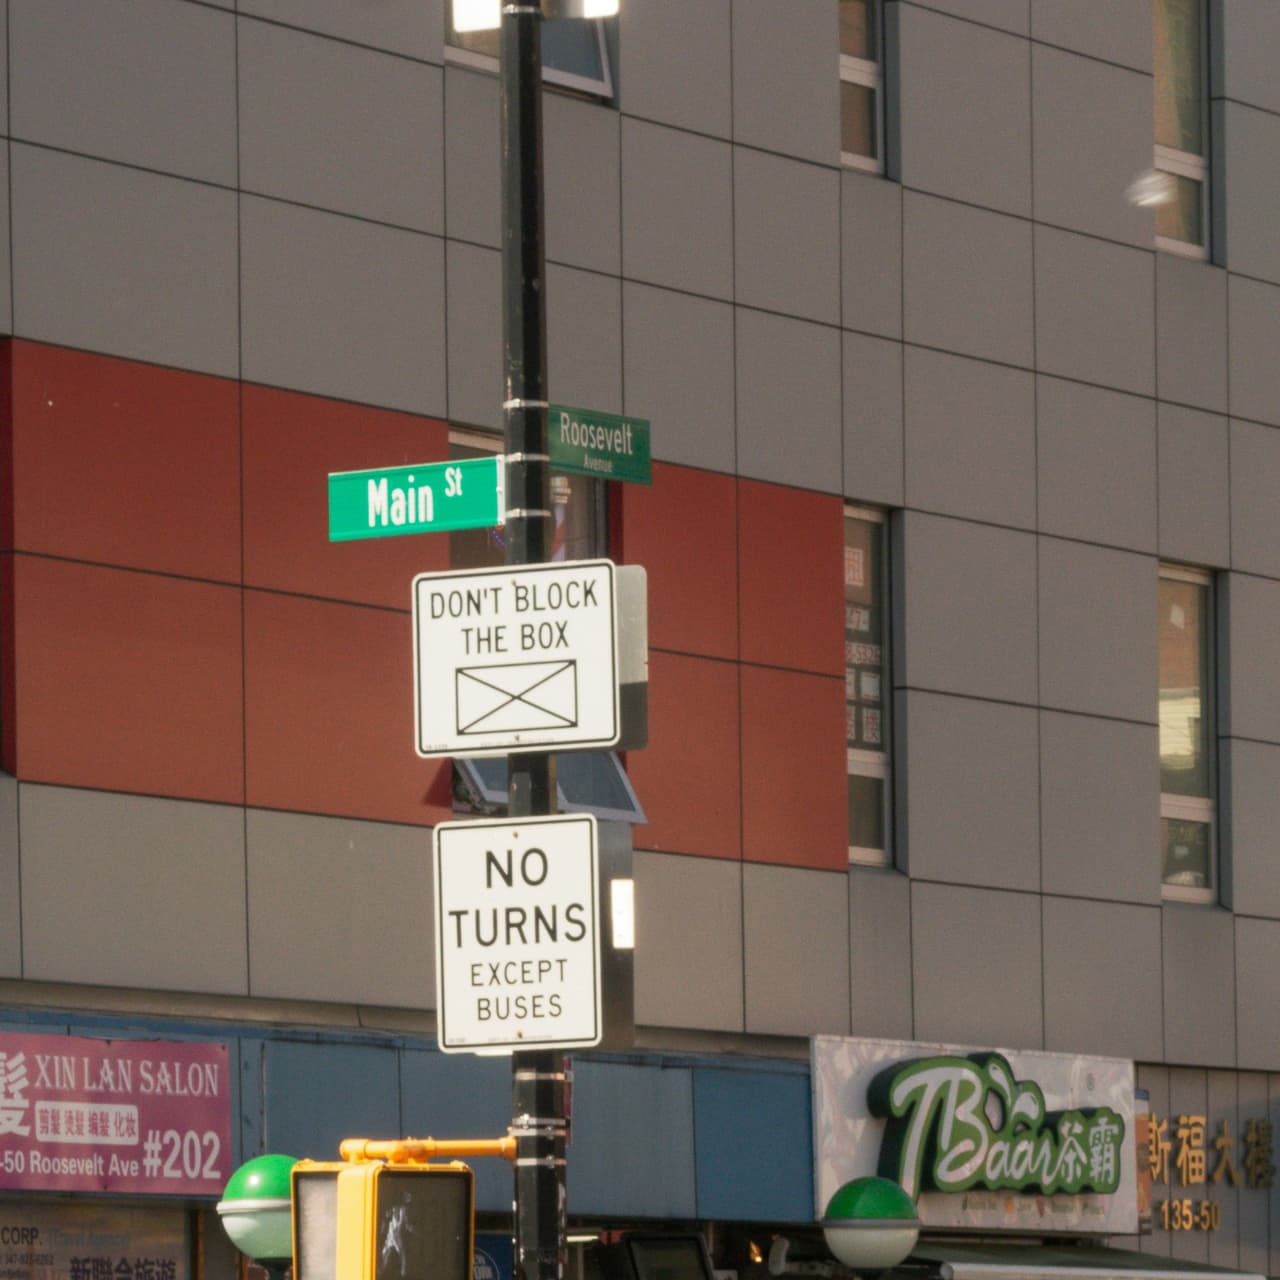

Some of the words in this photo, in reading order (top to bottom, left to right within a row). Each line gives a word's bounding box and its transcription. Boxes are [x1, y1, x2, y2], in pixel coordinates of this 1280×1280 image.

[560, 412, 633, 455] Roosevelt
[583, 454, 614, 473] Avenue
[367, 475, 433, 527] Main
[445, 467, 463, 497] St
[430, 587, 503, 619] DON'T
[514, 580, 598, 612] BLOCK
[461, 625, 508, 655] THE
[521, 621, 569, 650] BOX
[486, 848, 548, 888] NO
[448, 903, 587, 948] TURNS
[471, 958, 568, 987] EXCEPT
[477, 994, 562, 1021] BUSES
[35, 1055, 76, 1090] XIN
[83, 1059, 135, 1094] LAN
[140, 1061, 218, 1097] SALON
[30, 1151, 104, 1177] Roosevelt
[108, 1155, 139, 1177] Ave
[143, 1129, 221, 1179] #202
[1160, 1200, 1220, 1232] 135-50
[1, 1227, 42, 1246] CORP.
